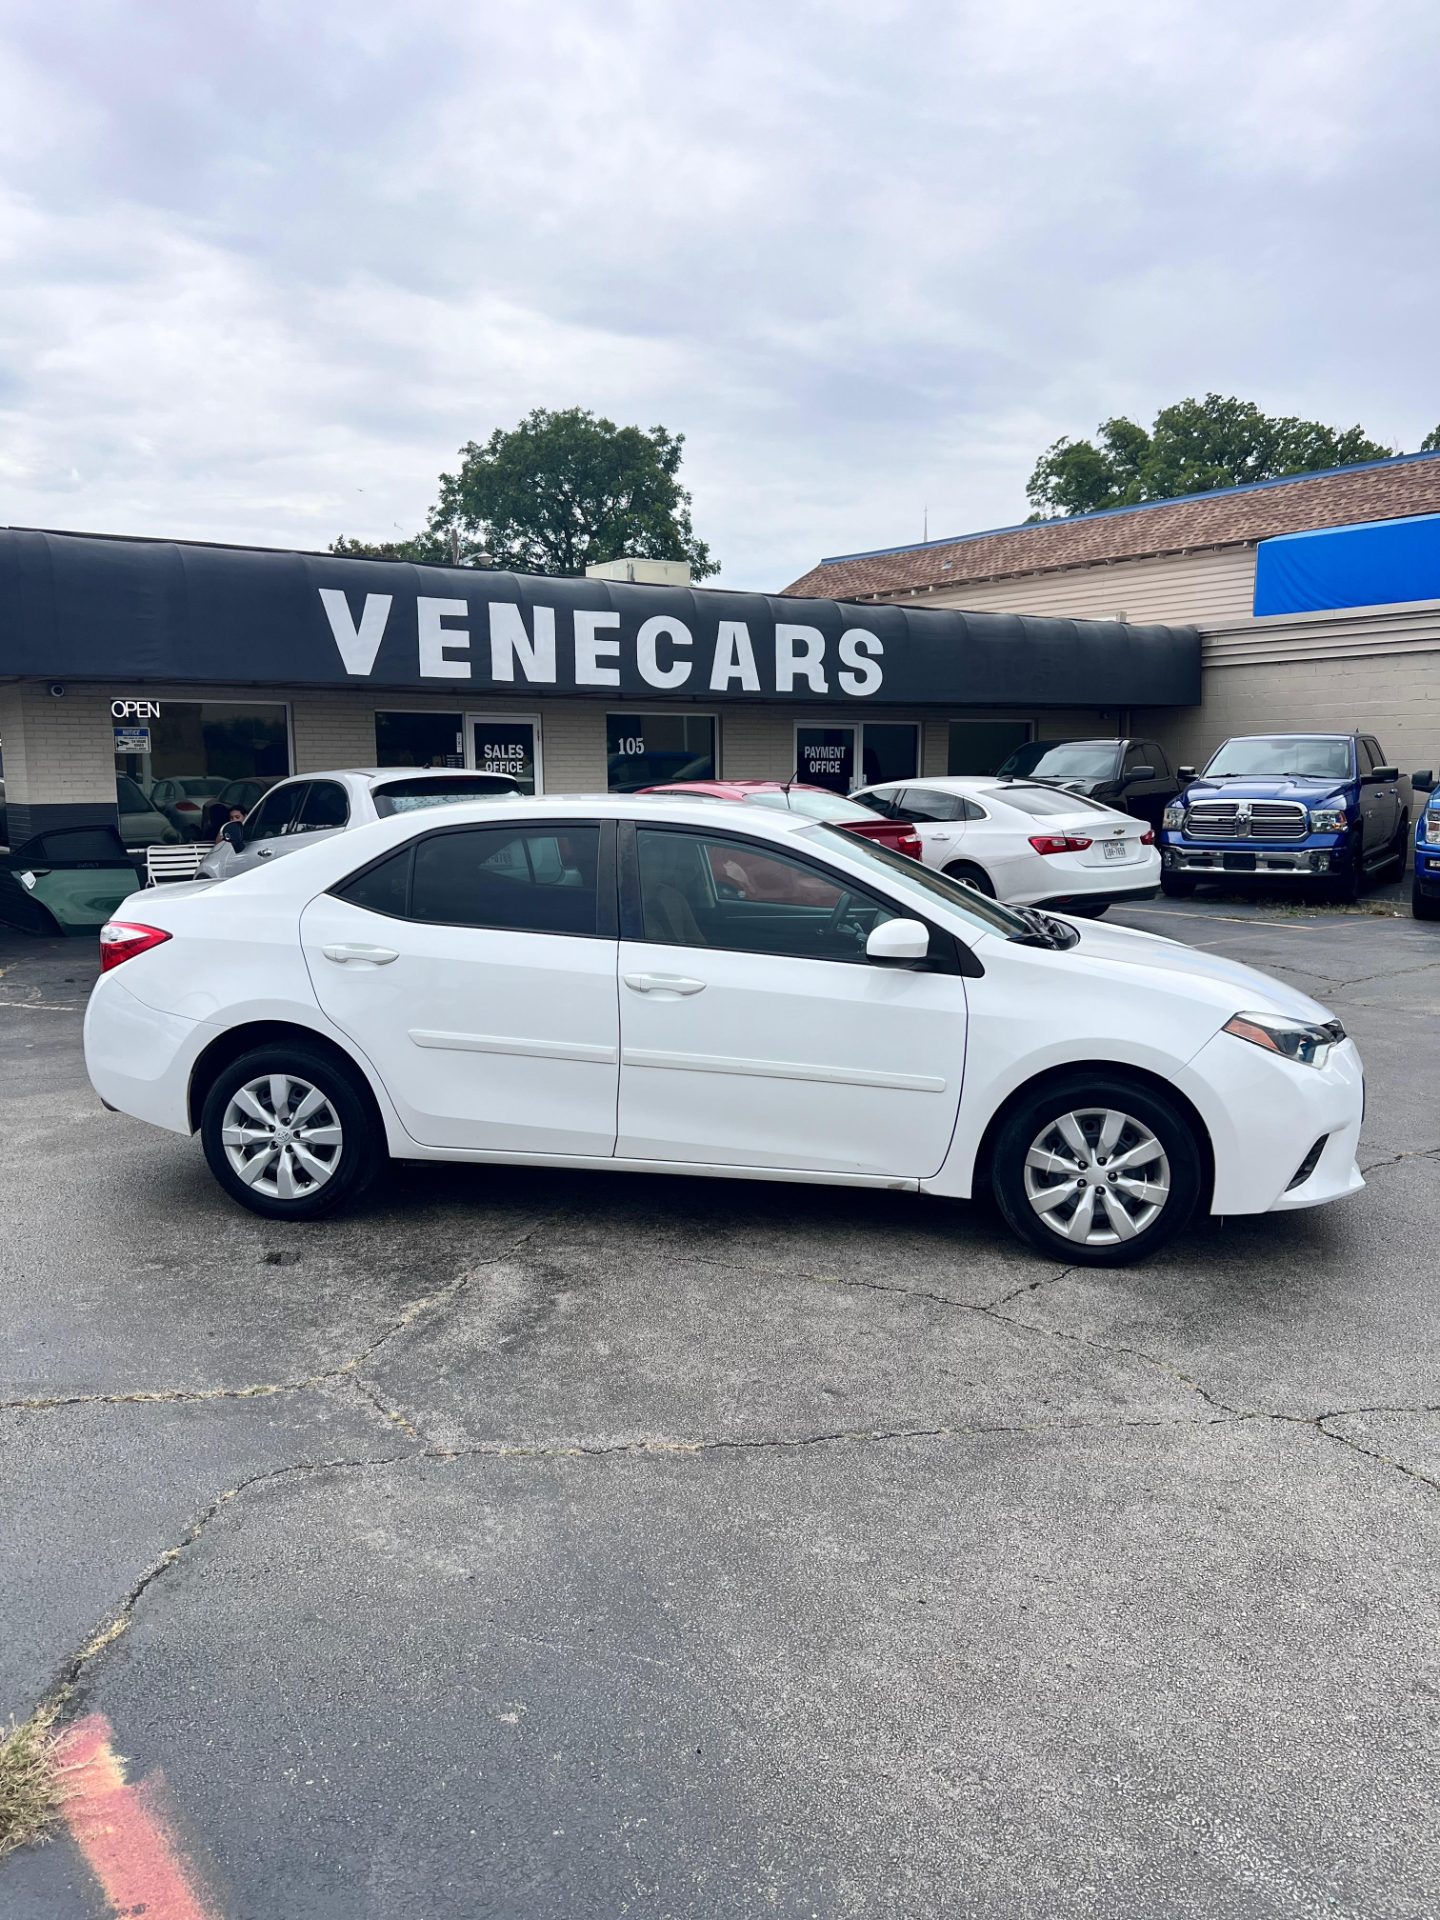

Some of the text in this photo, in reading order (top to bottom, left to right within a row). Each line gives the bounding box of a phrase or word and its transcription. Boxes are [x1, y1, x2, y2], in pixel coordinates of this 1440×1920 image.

[318, 588, 884, 697] VENECARS
[111, 700, 160, 719] OPEN
[484, 744, 524, 759] SALES
[618, 737, 645, 755] 105
[804, 746, 846, 759] PAYMENT
[485, 761, 524, 773] OFFICE
[809, 761, 841, 773] OFFICE
